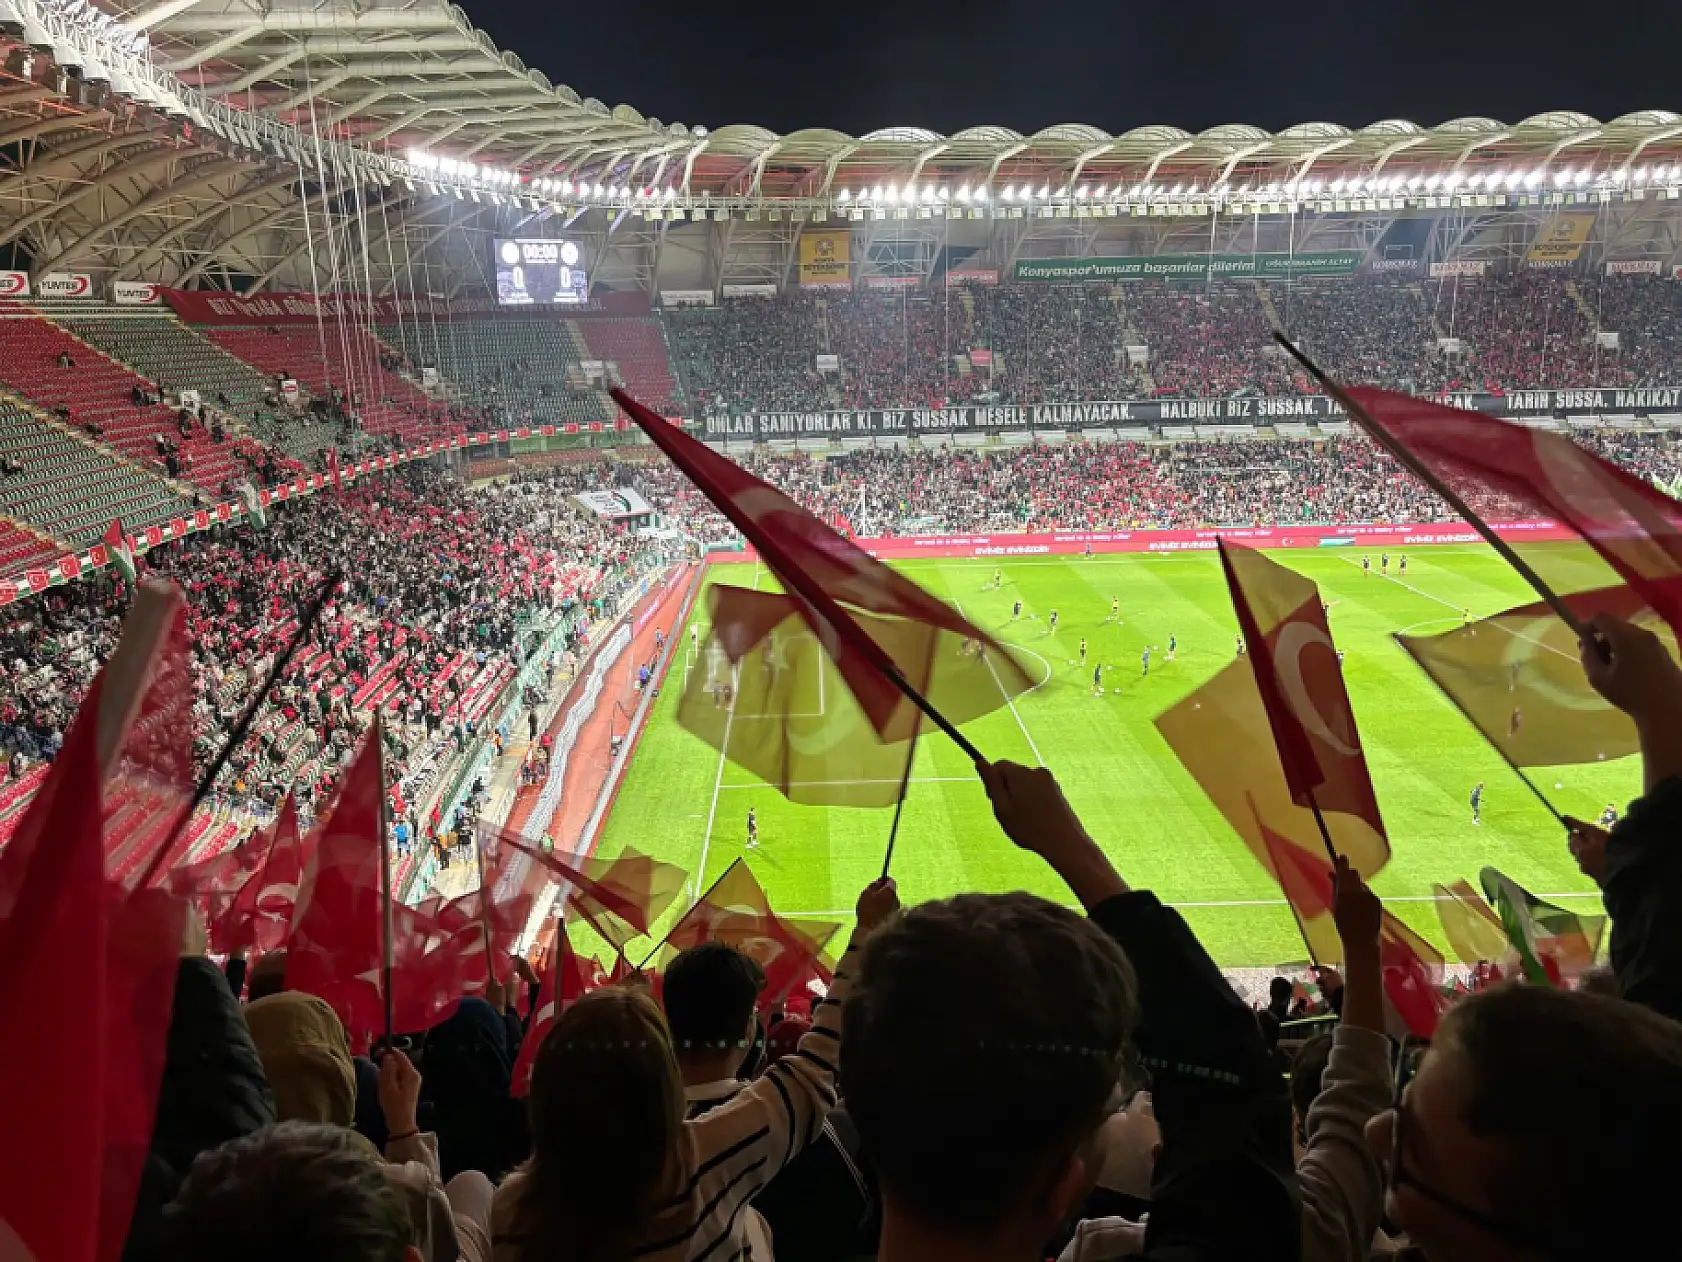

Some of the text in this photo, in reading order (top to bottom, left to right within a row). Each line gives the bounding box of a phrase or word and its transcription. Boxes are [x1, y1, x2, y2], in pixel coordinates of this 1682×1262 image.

[707, 415, 753, 433] ONLAR
[759, 411, 851, 432] SANIYORLAR
[975, 407, 1027, 426] MESELE
